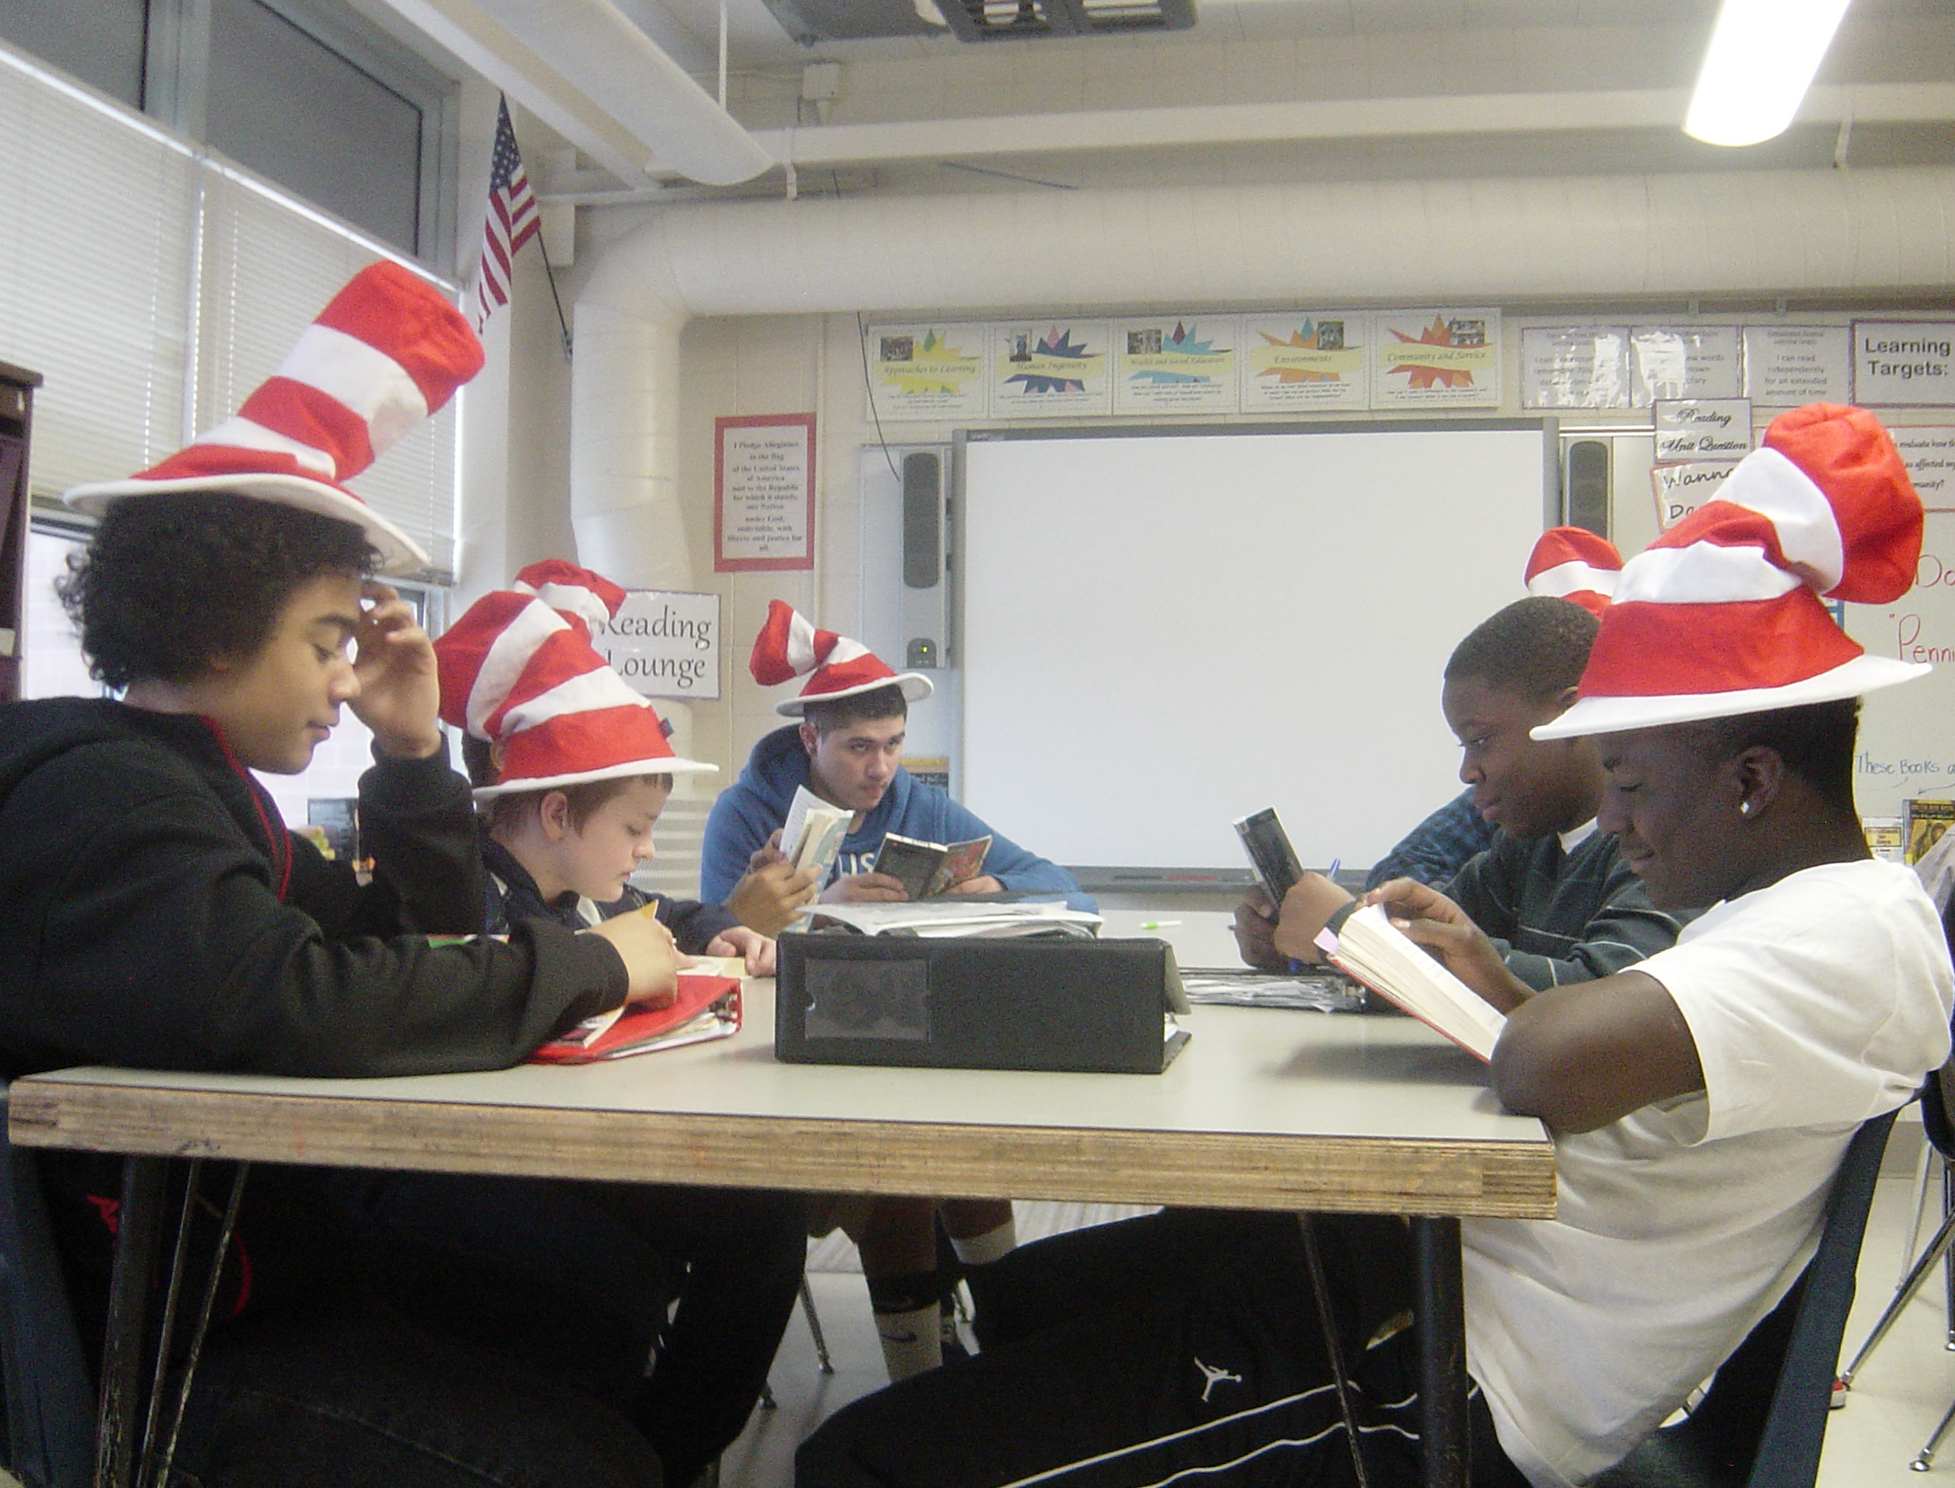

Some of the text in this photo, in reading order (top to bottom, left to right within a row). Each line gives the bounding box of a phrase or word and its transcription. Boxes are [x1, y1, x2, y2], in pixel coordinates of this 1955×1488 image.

[1865, 338, 1951, 357] Learning
[1676, 408, 1732, 428] Reading
[1662, 436, 1747, 452] Unit Question
[1915, 458, 1945, 471] affected
[1854, 750, 1896, 775] These
